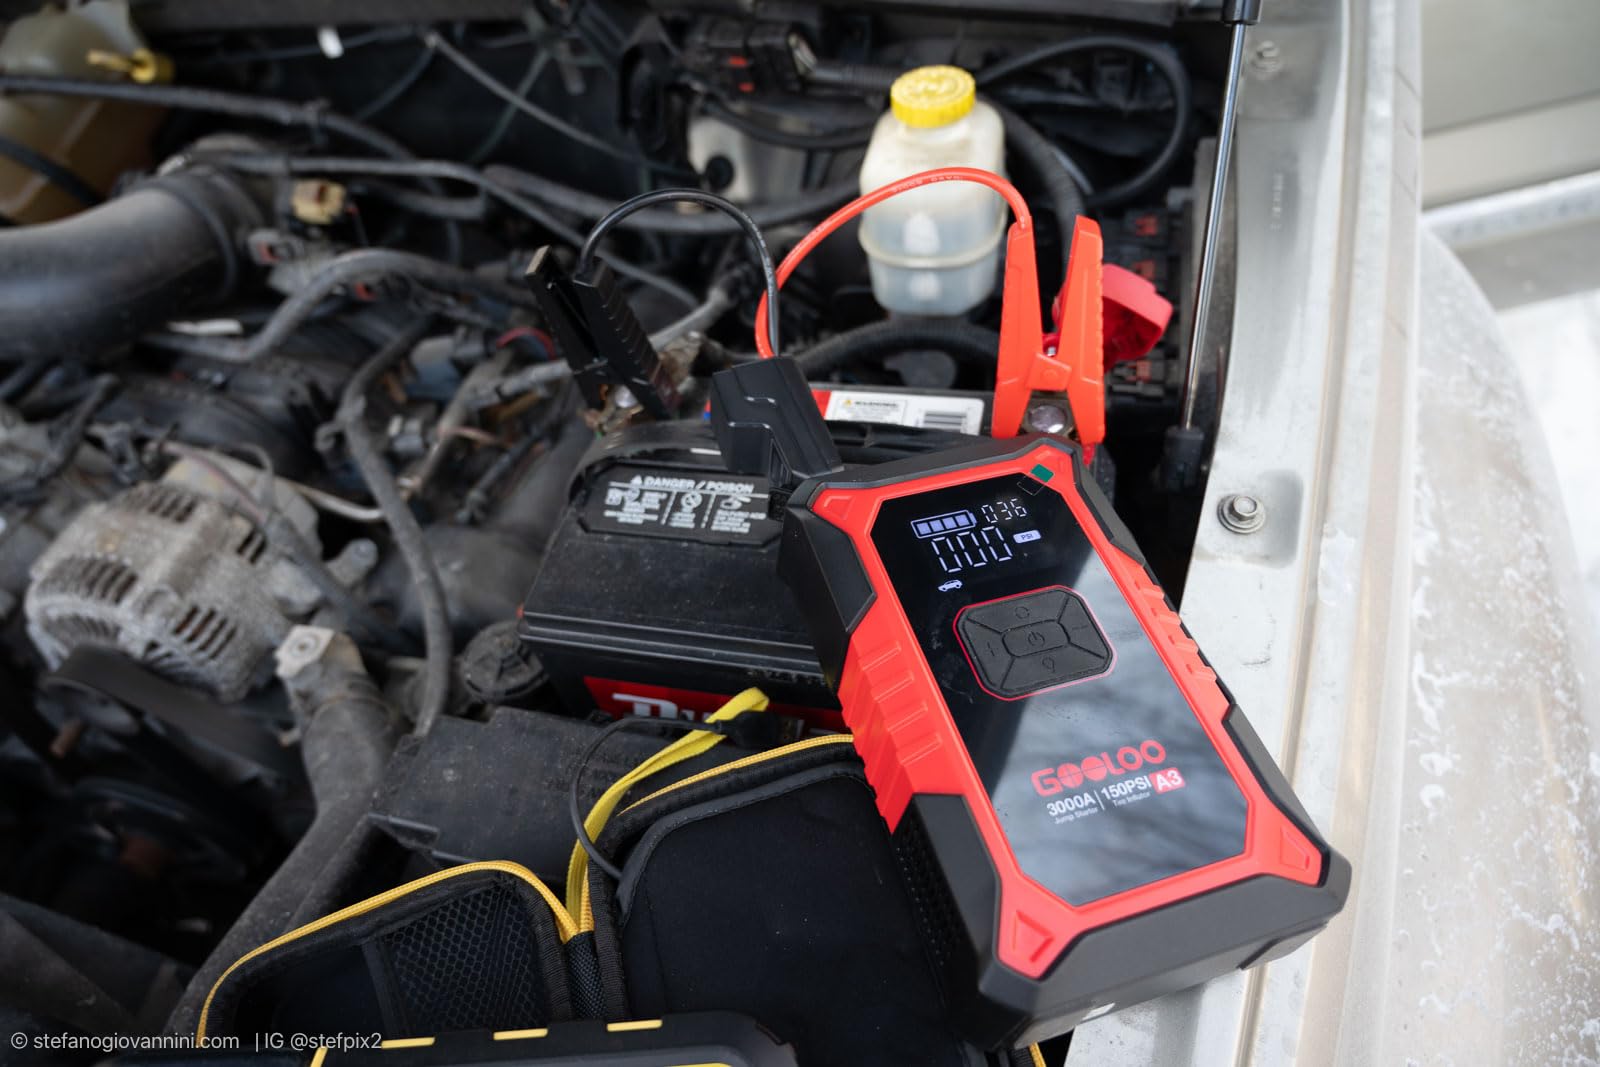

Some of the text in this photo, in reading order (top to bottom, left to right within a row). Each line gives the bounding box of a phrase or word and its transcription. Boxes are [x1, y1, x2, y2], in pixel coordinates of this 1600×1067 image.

[981, 498, 1028, 523] 036
[931, 526, 1013, 573] 000
[1031, 739, 1167, 797] GOOLOO
[1046, 770, 1183, 816] 3000A 150PSI A3
